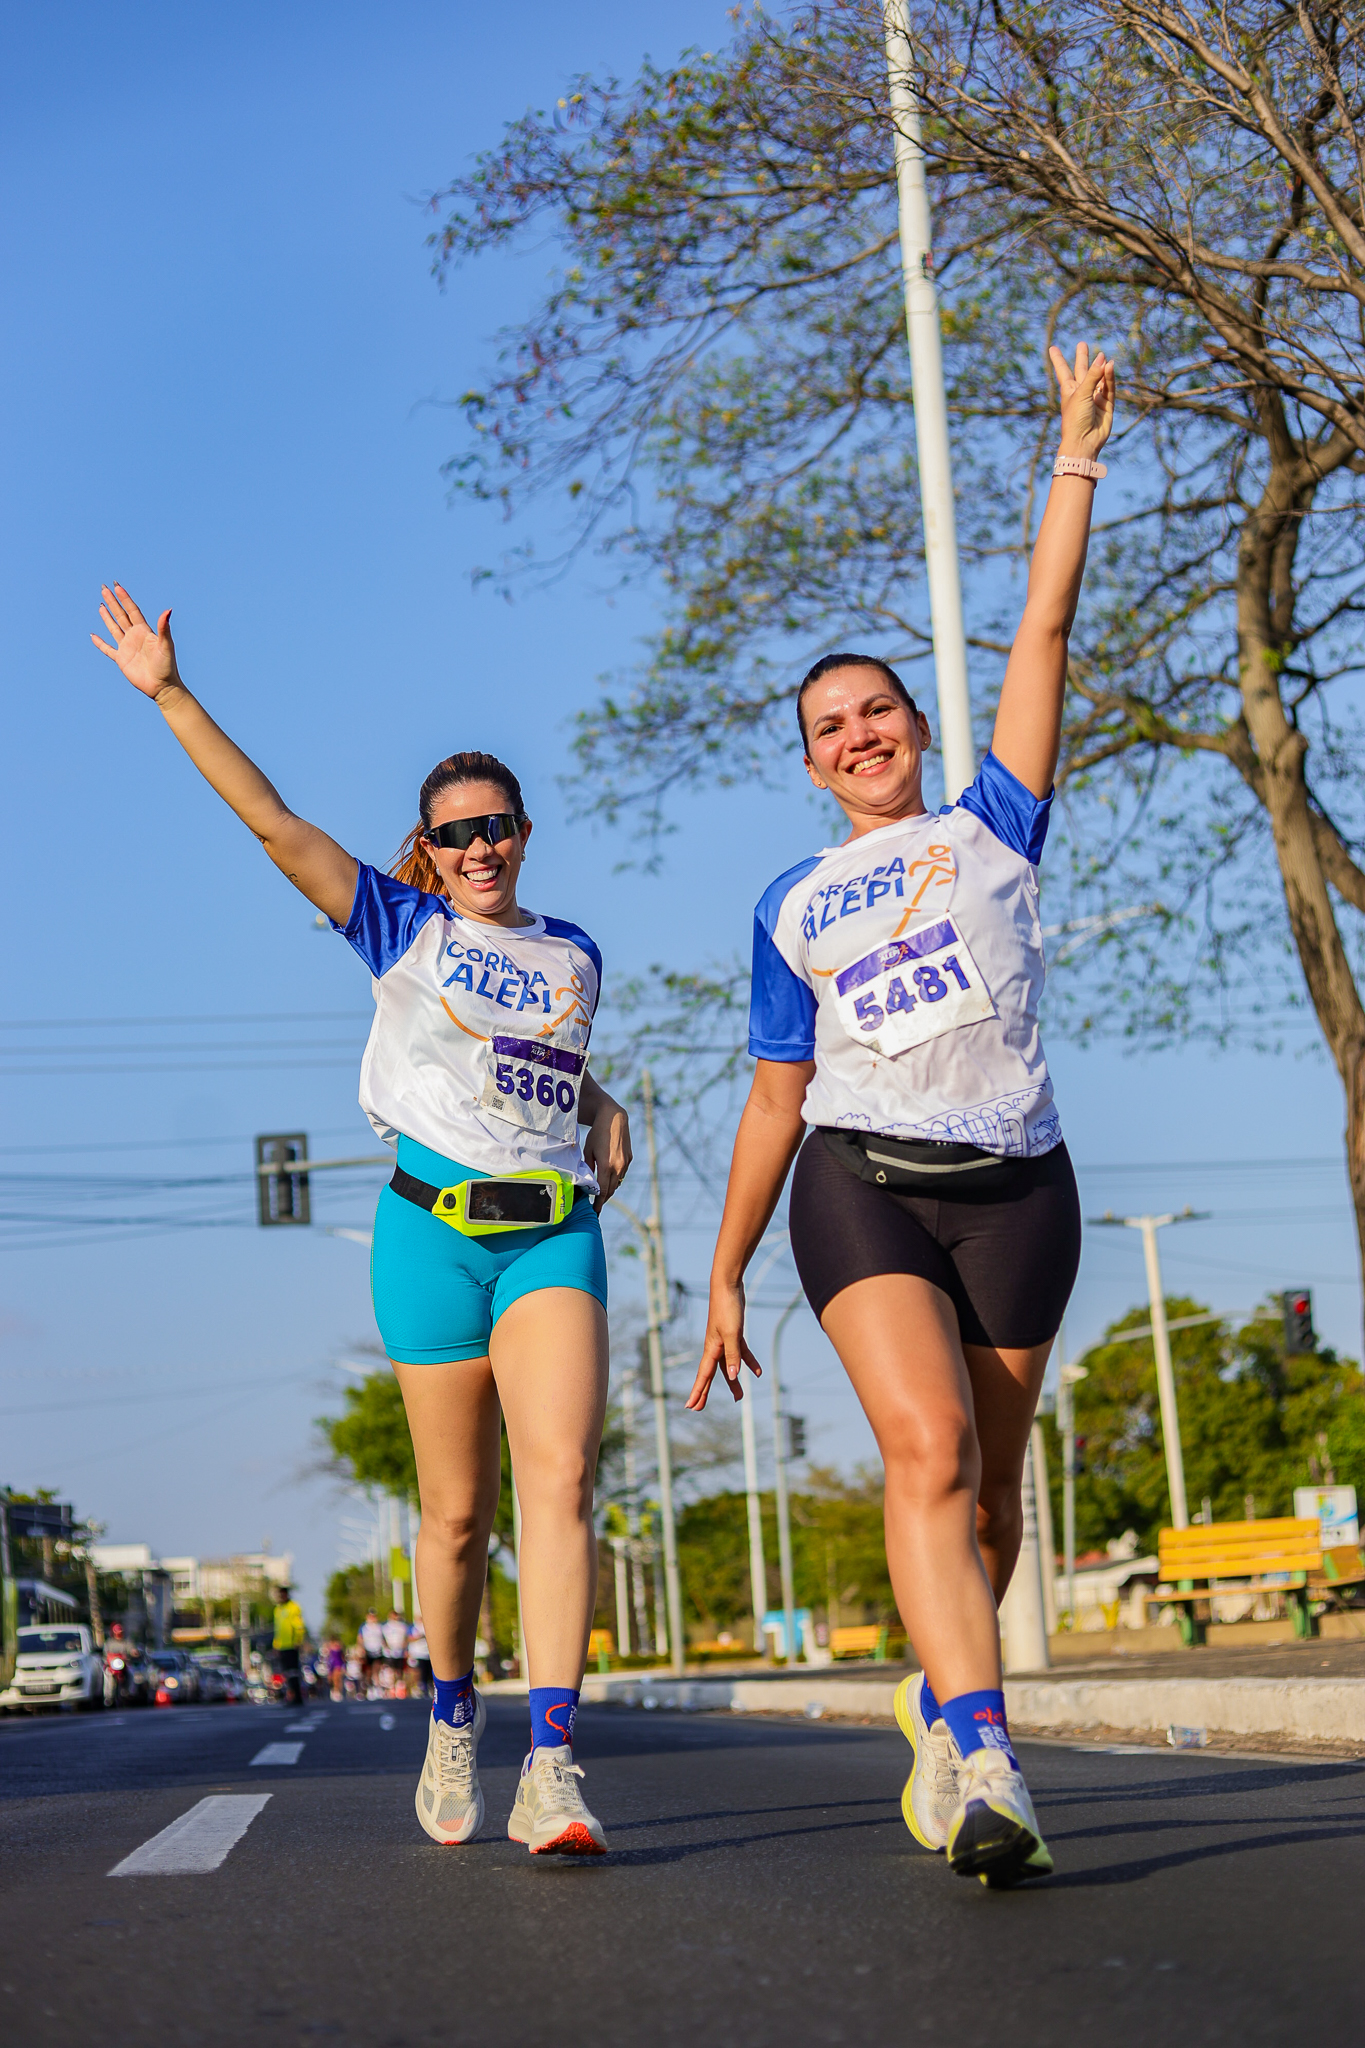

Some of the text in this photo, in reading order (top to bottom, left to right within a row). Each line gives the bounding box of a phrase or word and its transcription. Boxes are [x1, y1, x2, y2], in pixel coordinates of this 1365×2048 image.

[803, 876, 904, 941] ALEPI
[442, 962, 552, 1014] ALEPI
[446, 940, 549, 988] CORRDA
[853, 954, 971, 1031] 5481
[496, 1063, 576, 1113] 5360
